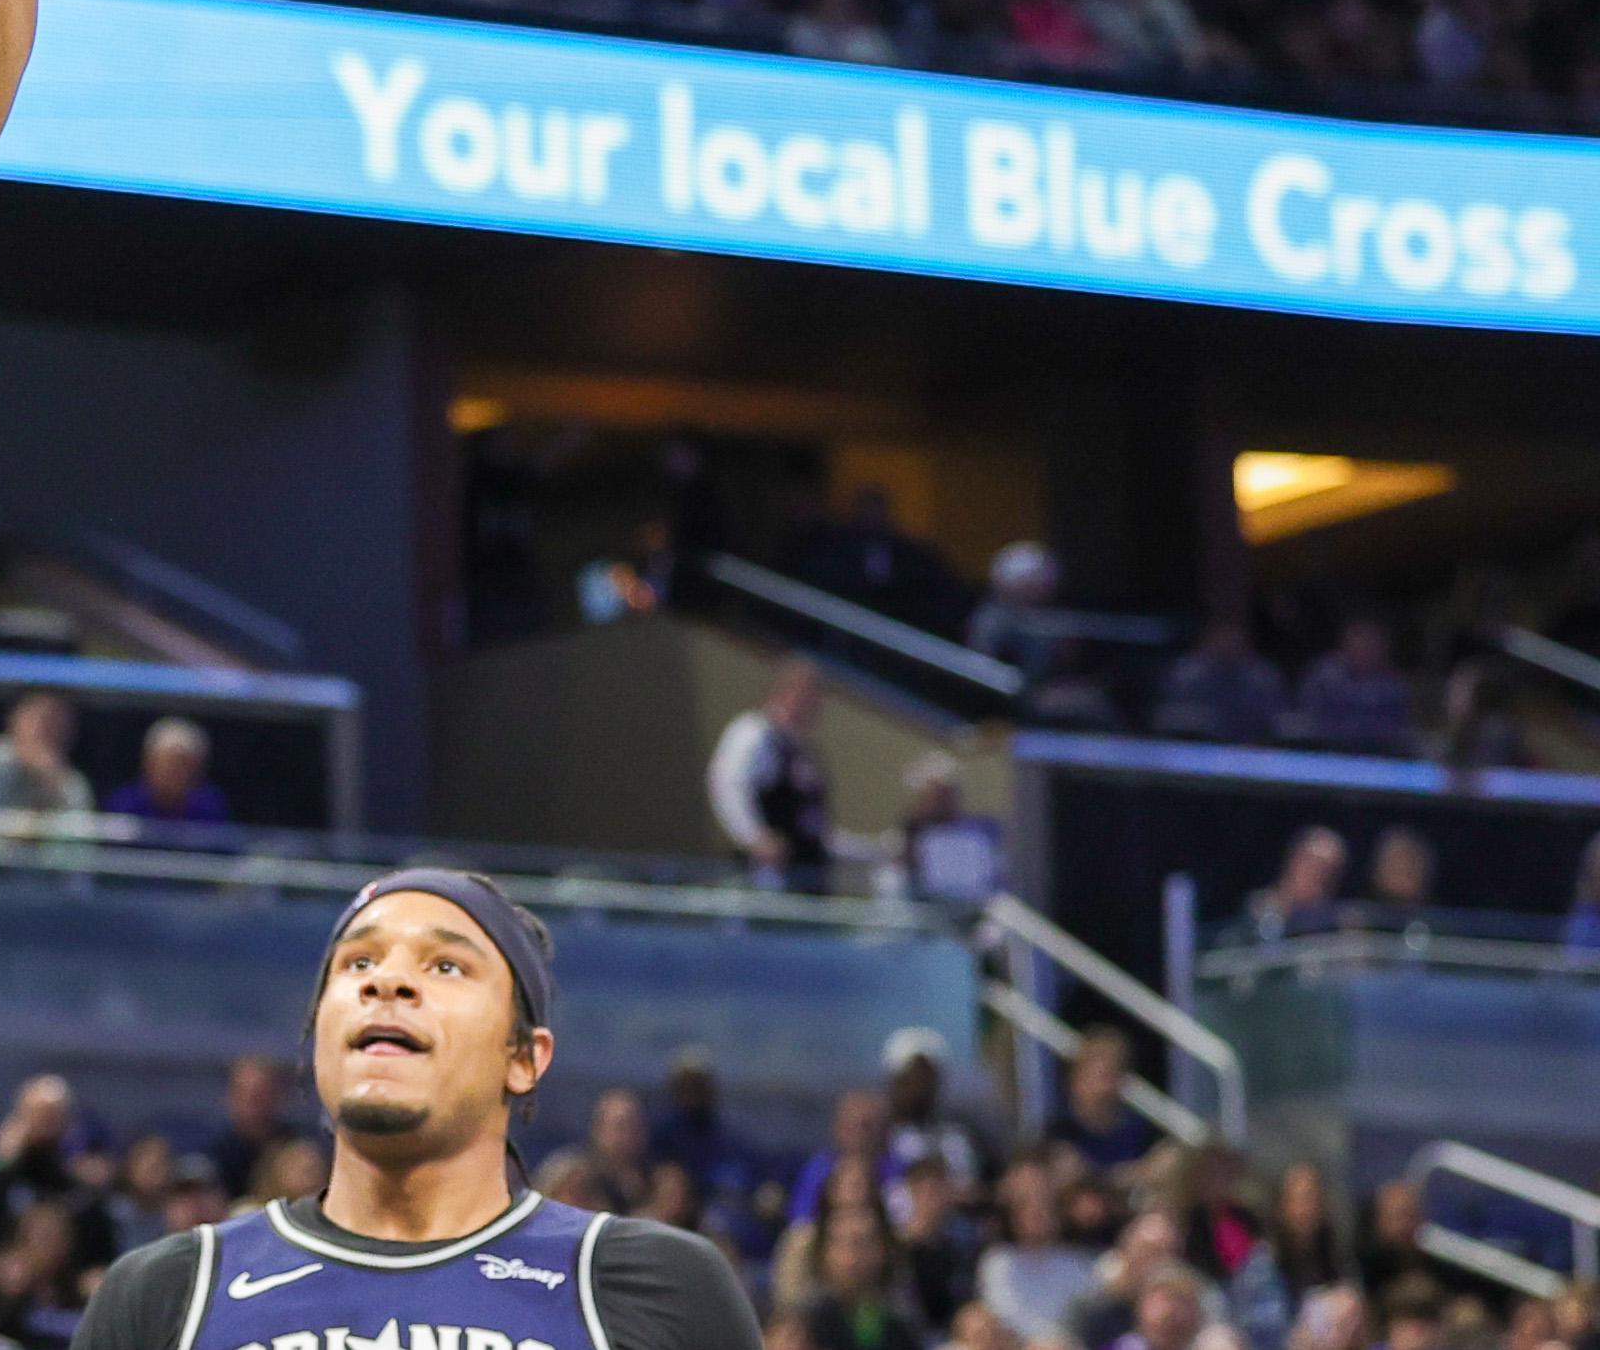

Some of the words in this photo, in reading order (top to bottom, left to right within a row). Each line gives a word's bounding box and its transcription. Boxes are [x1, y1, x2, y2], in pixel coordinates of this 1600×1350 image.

[333, 50, 628, 203] Your
[660, 80, 931, 237] local
[965, 122, 1220, 267] Blue
[1246, 151, 1577, 301] Cross
